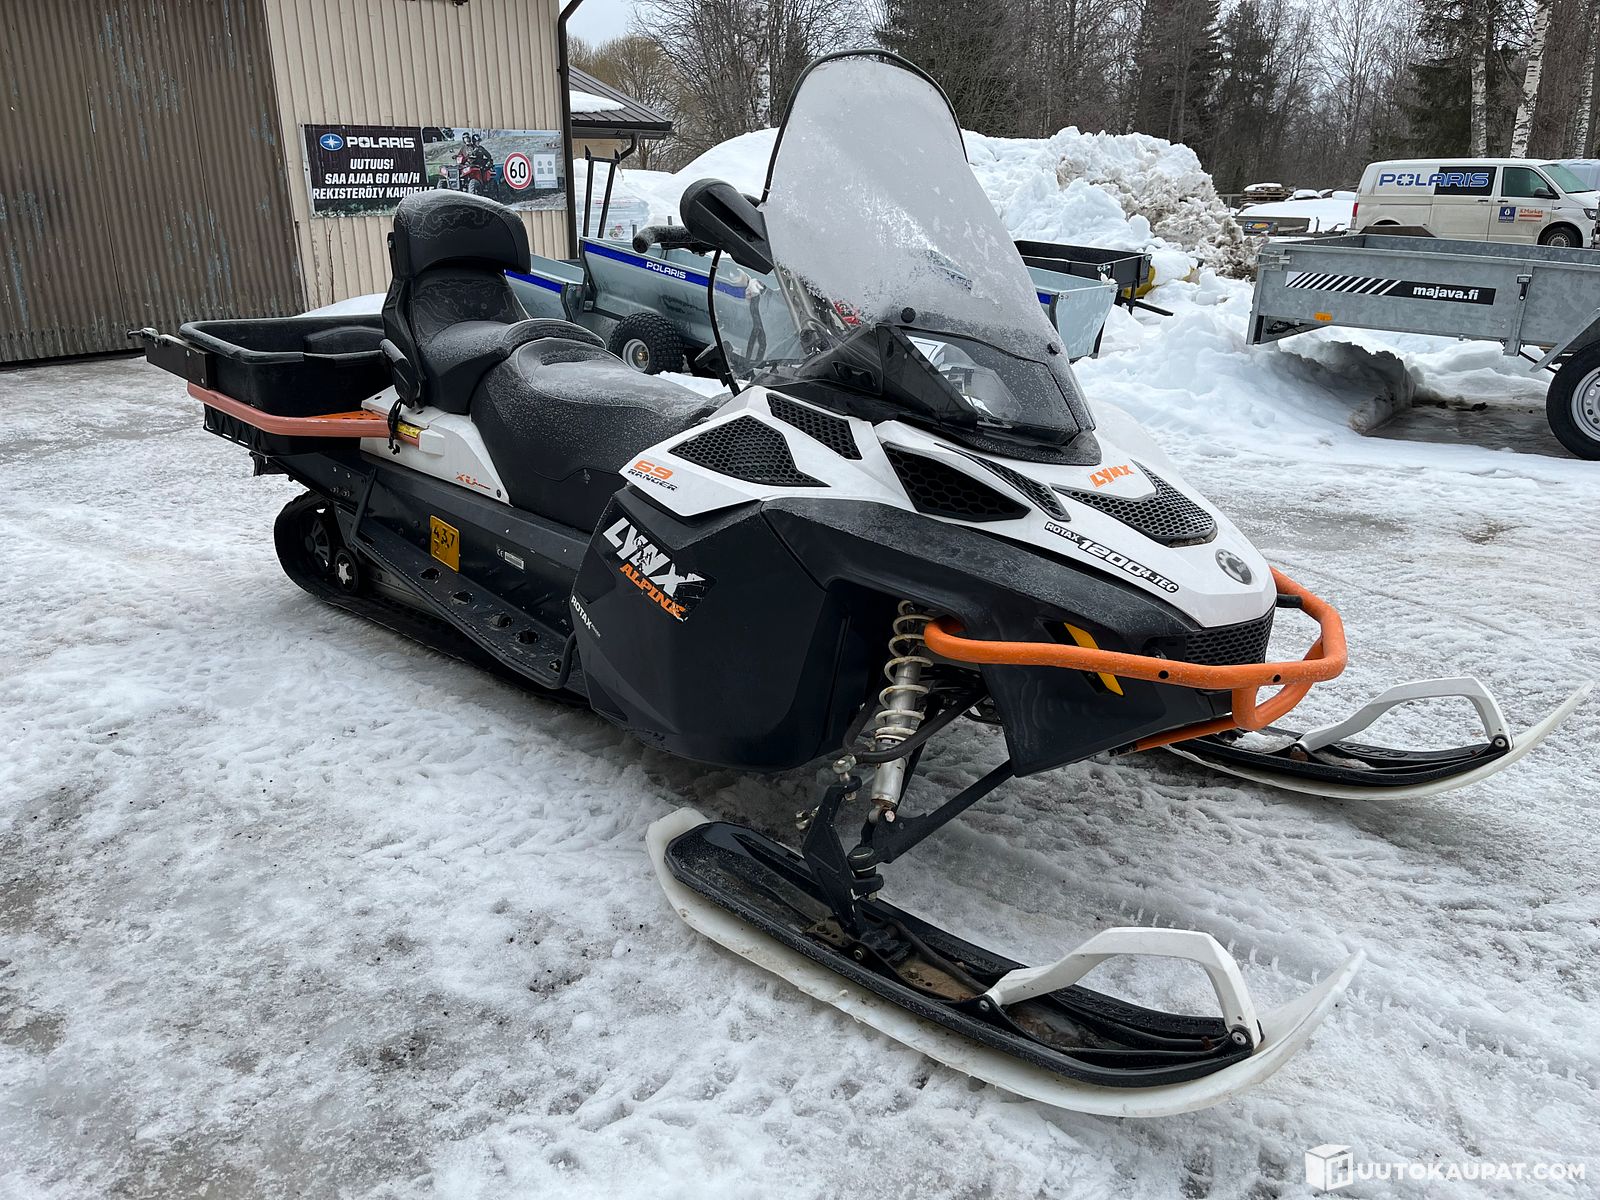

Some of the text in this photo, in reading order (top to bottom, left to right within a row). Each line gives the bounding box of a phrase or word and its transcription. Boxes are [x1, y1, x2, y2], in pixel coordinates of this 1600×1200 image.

[346, 136, 415, 149] POLARIS
[349, 158, 394, 170] UUTUUS!
[510, 162, 526, 179] 60
[325, 171, 420, 184] SAA AJAA 60 KM/H
[1378, 172, 1490, 188] POLARIS
[645, 261, 686, 279] POLARIS
[1412, 285, 1479, 301] majava.fi
[634, 460, 673, 480] 69
[1090, 465, 1134, 487] LYNX
[628, 469, 678, 491] RANGER
[1045, 522, 1080, 542] ROTAX
[603, 517, 706, 598] LYNX
[619, 563, 686, 619] ALPINE
[571, 595, 592, 629] ROTAX
